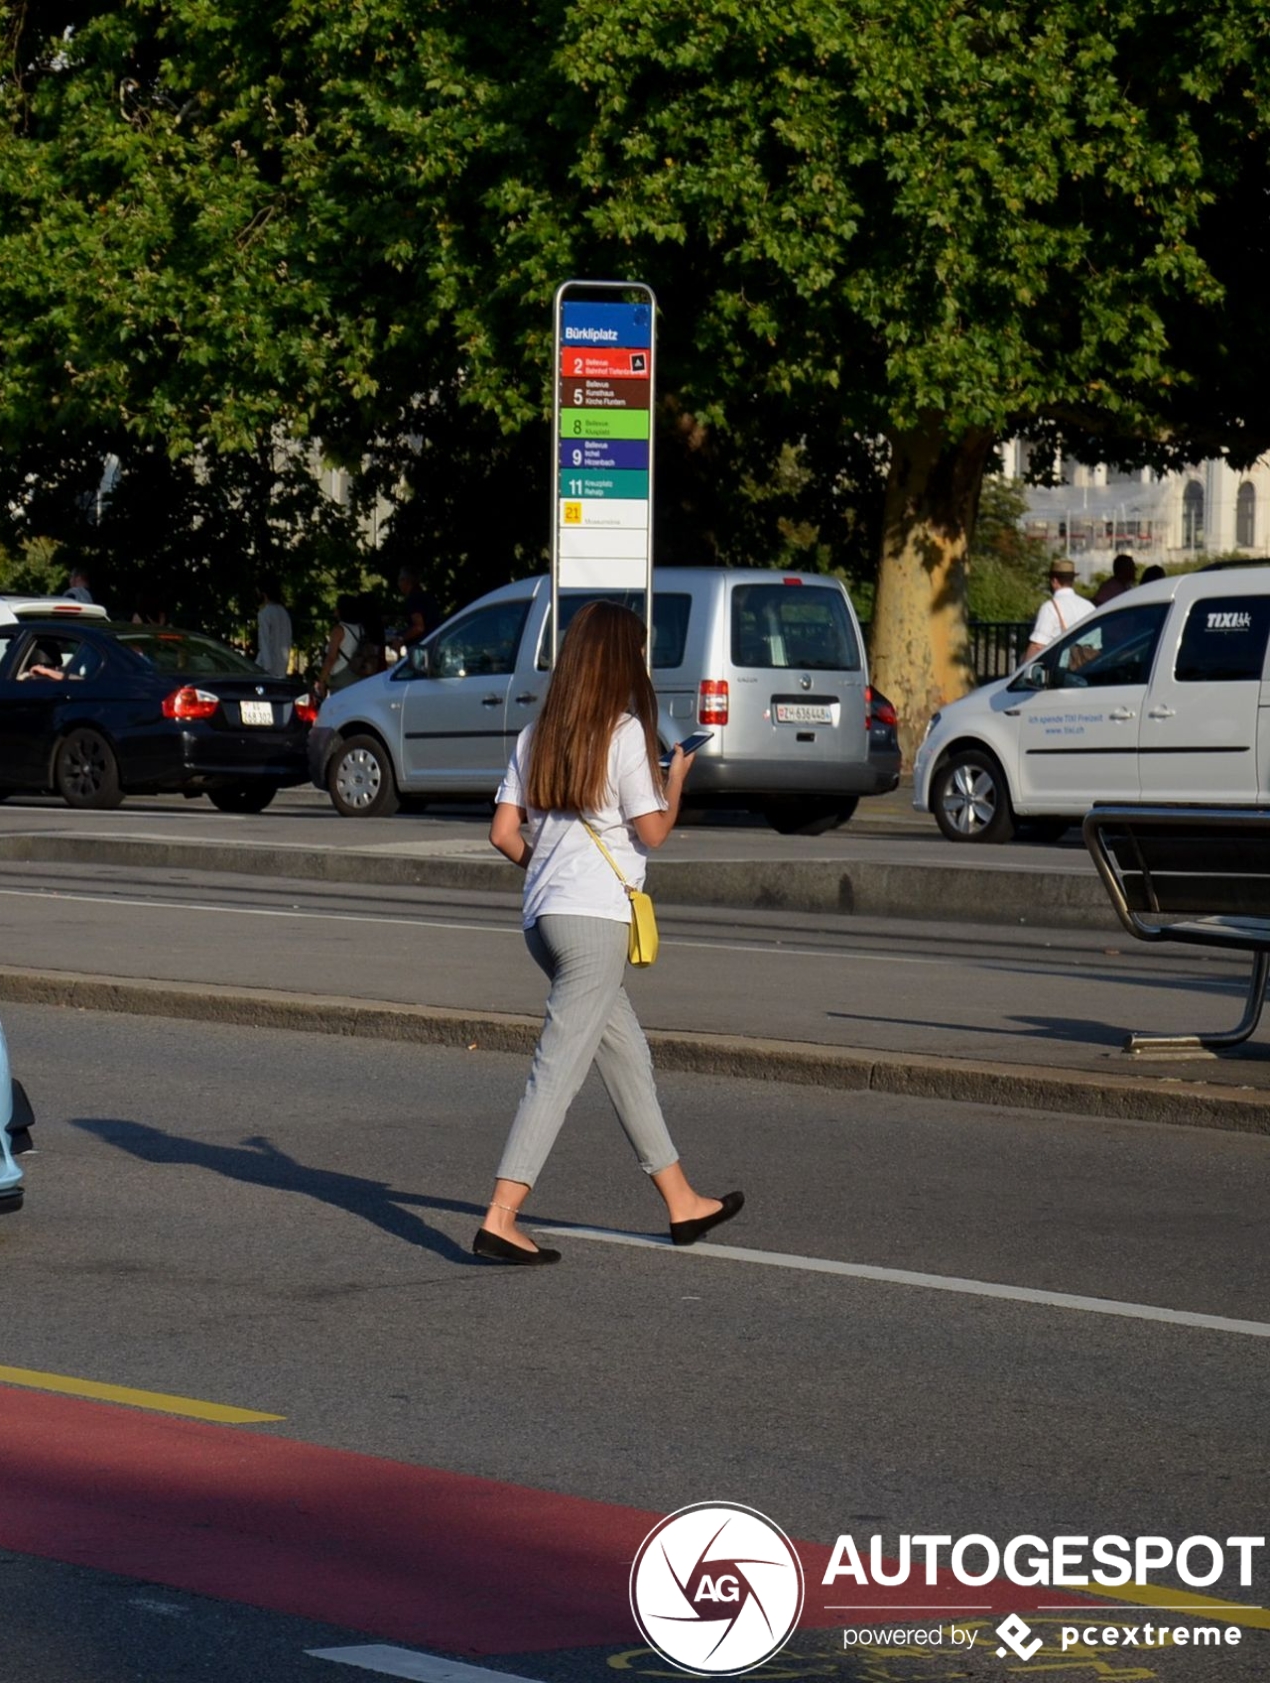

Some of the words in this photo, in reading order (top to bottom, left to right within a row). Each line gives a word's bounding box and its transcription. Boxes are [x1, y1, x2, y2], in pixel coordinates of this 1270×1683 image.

[565, 327, 619, 343] Bürkliplatz
[573, 358, 584, 375] 2
[586, 380, 610, 389] Bellevue
[573, 389, 584, 405] 5
[573, 419, 582, 435] 8
[572, 449, 582, 466] 9
[569, 479, 583, 496] 11
[565, 508, 579, 519] 21
[1207, 612, 1239, 628] TIXI
